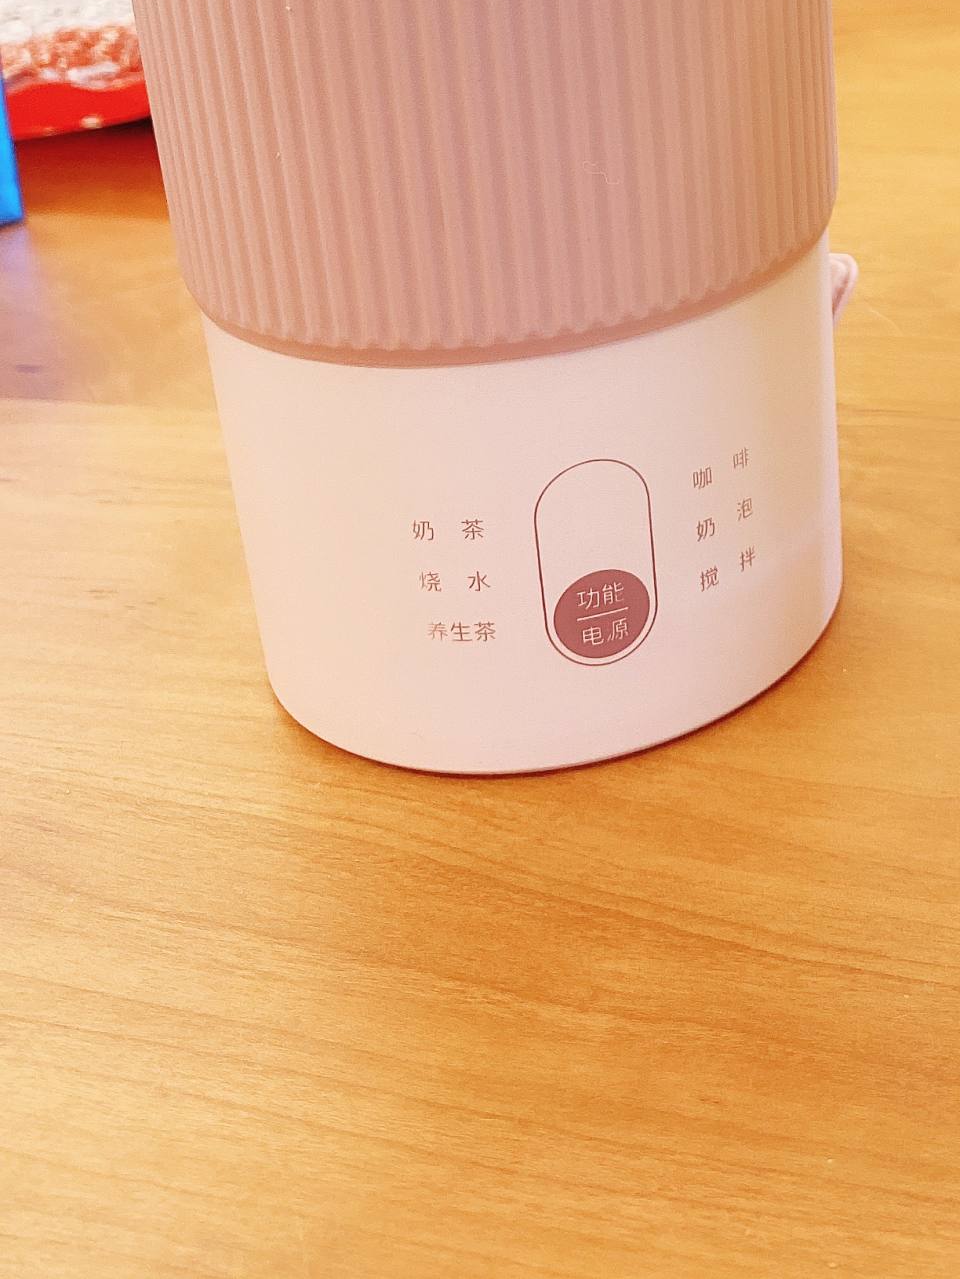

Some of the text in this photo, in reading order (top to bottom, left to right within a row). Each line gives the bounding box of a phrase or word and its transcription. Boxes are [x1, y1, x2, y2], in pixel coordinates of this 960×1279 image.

[411, 518, 485, 541] 奶茶
[418, 570, 491, 592] 烧水
[576, 582, 625, 610] 功能
[427, 621, 497, 643] 养生茶
[581, 618, 630, 646] 电源
